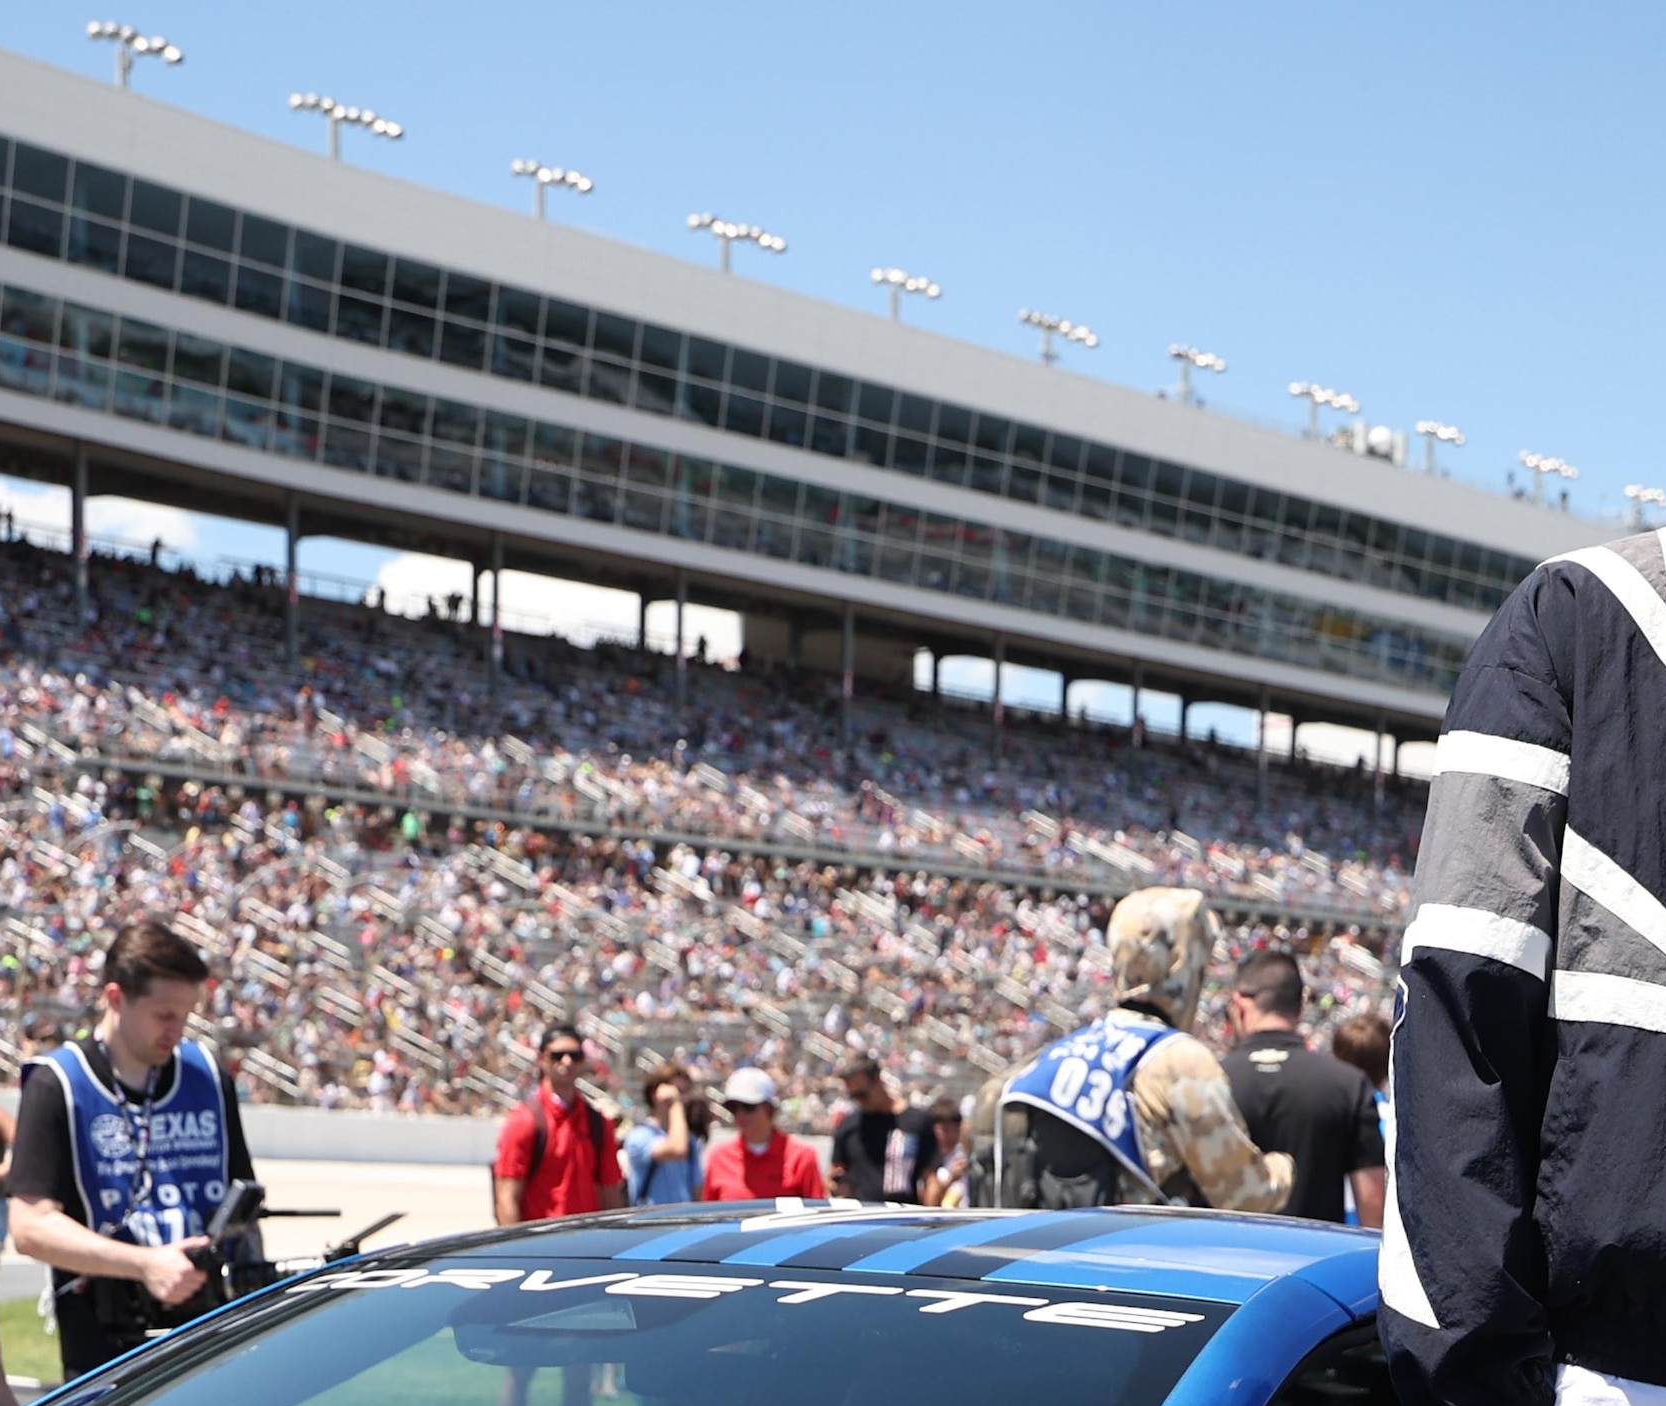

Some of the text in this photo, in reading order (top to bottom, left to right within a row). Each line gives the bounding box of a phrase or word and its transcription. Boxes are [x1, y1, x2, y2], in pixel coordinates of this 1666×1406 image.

[149, 1109, 217, 1141] EXAS
[99, 1180, 226, 1211] POTO
[286, 1268, 1205, 1333] CORVETTE
